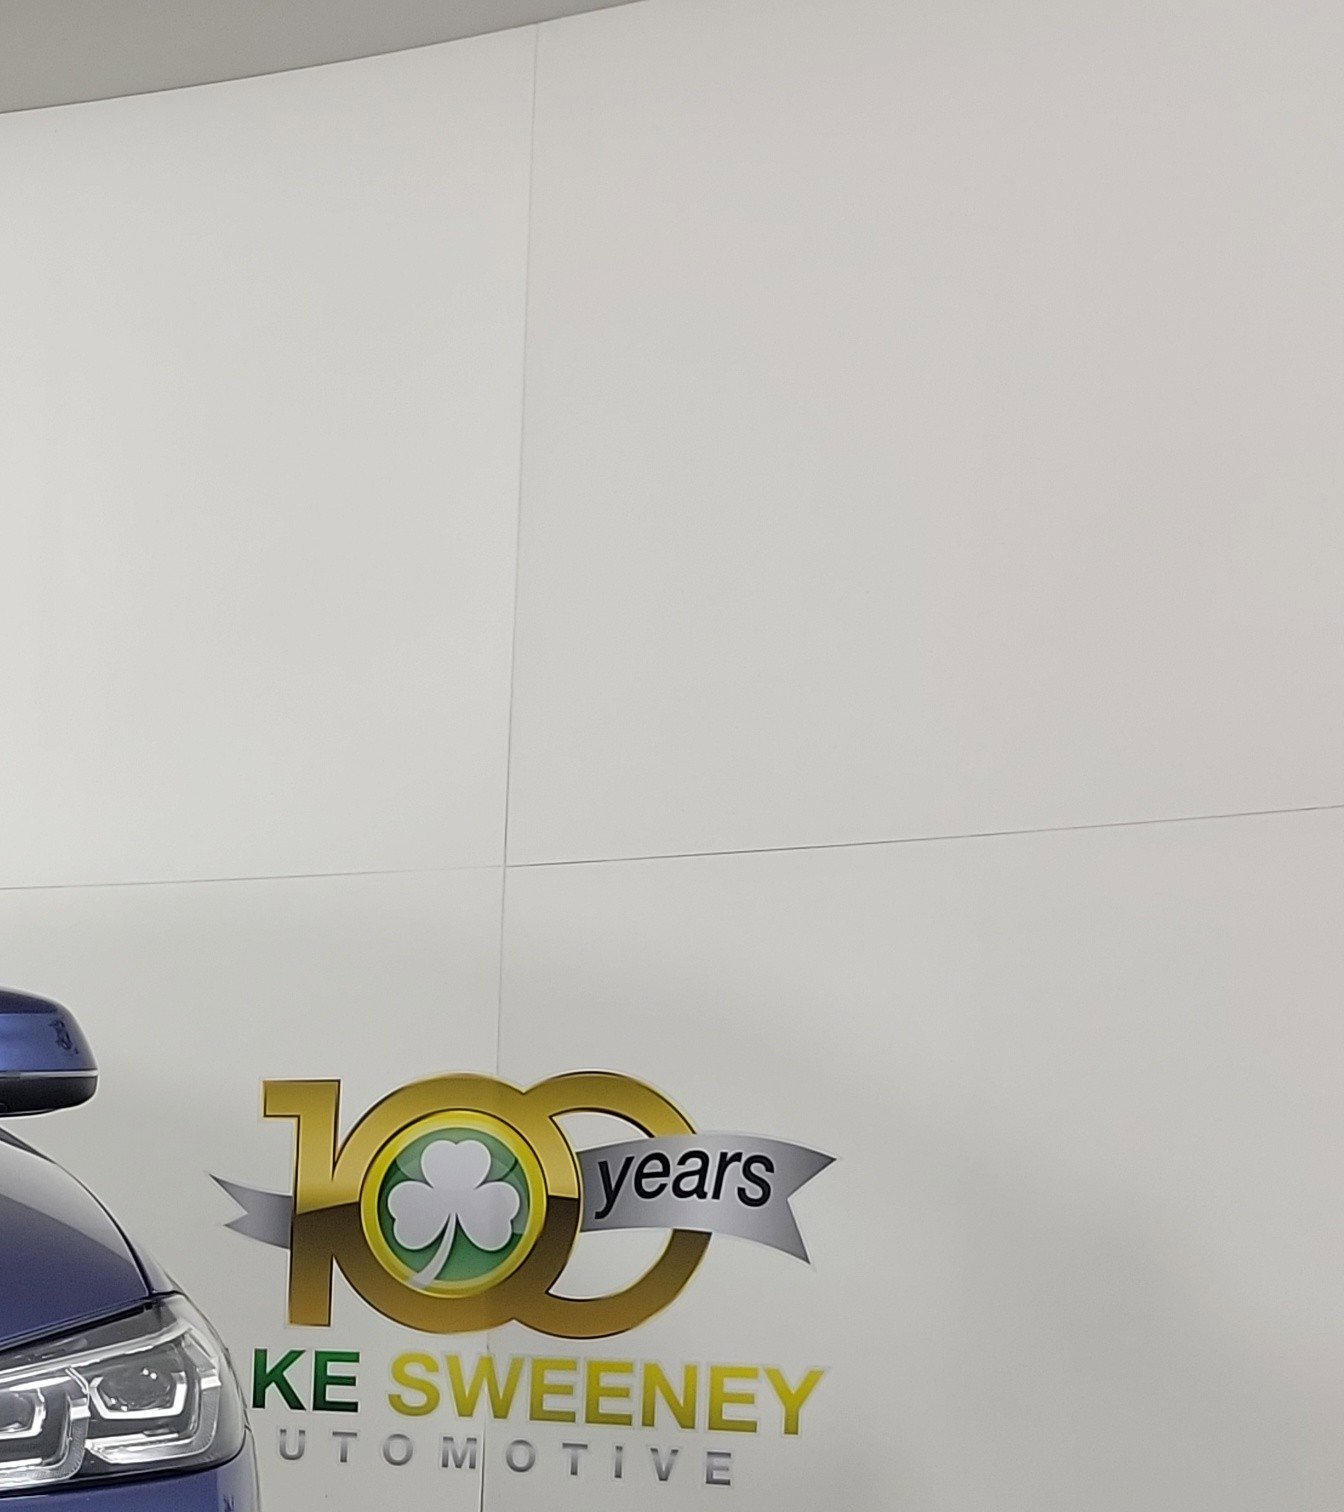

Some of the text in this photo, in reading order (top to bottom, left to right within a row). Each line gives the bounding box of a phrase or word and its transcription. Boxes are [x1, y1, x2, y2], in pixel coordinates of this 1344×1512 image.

[261, 1070, 775, 1340] 100 years
[252, 1348, 825, 1436] KE SWEENEY
[279, 1429, 732, 1486] UTOMOTIVE
